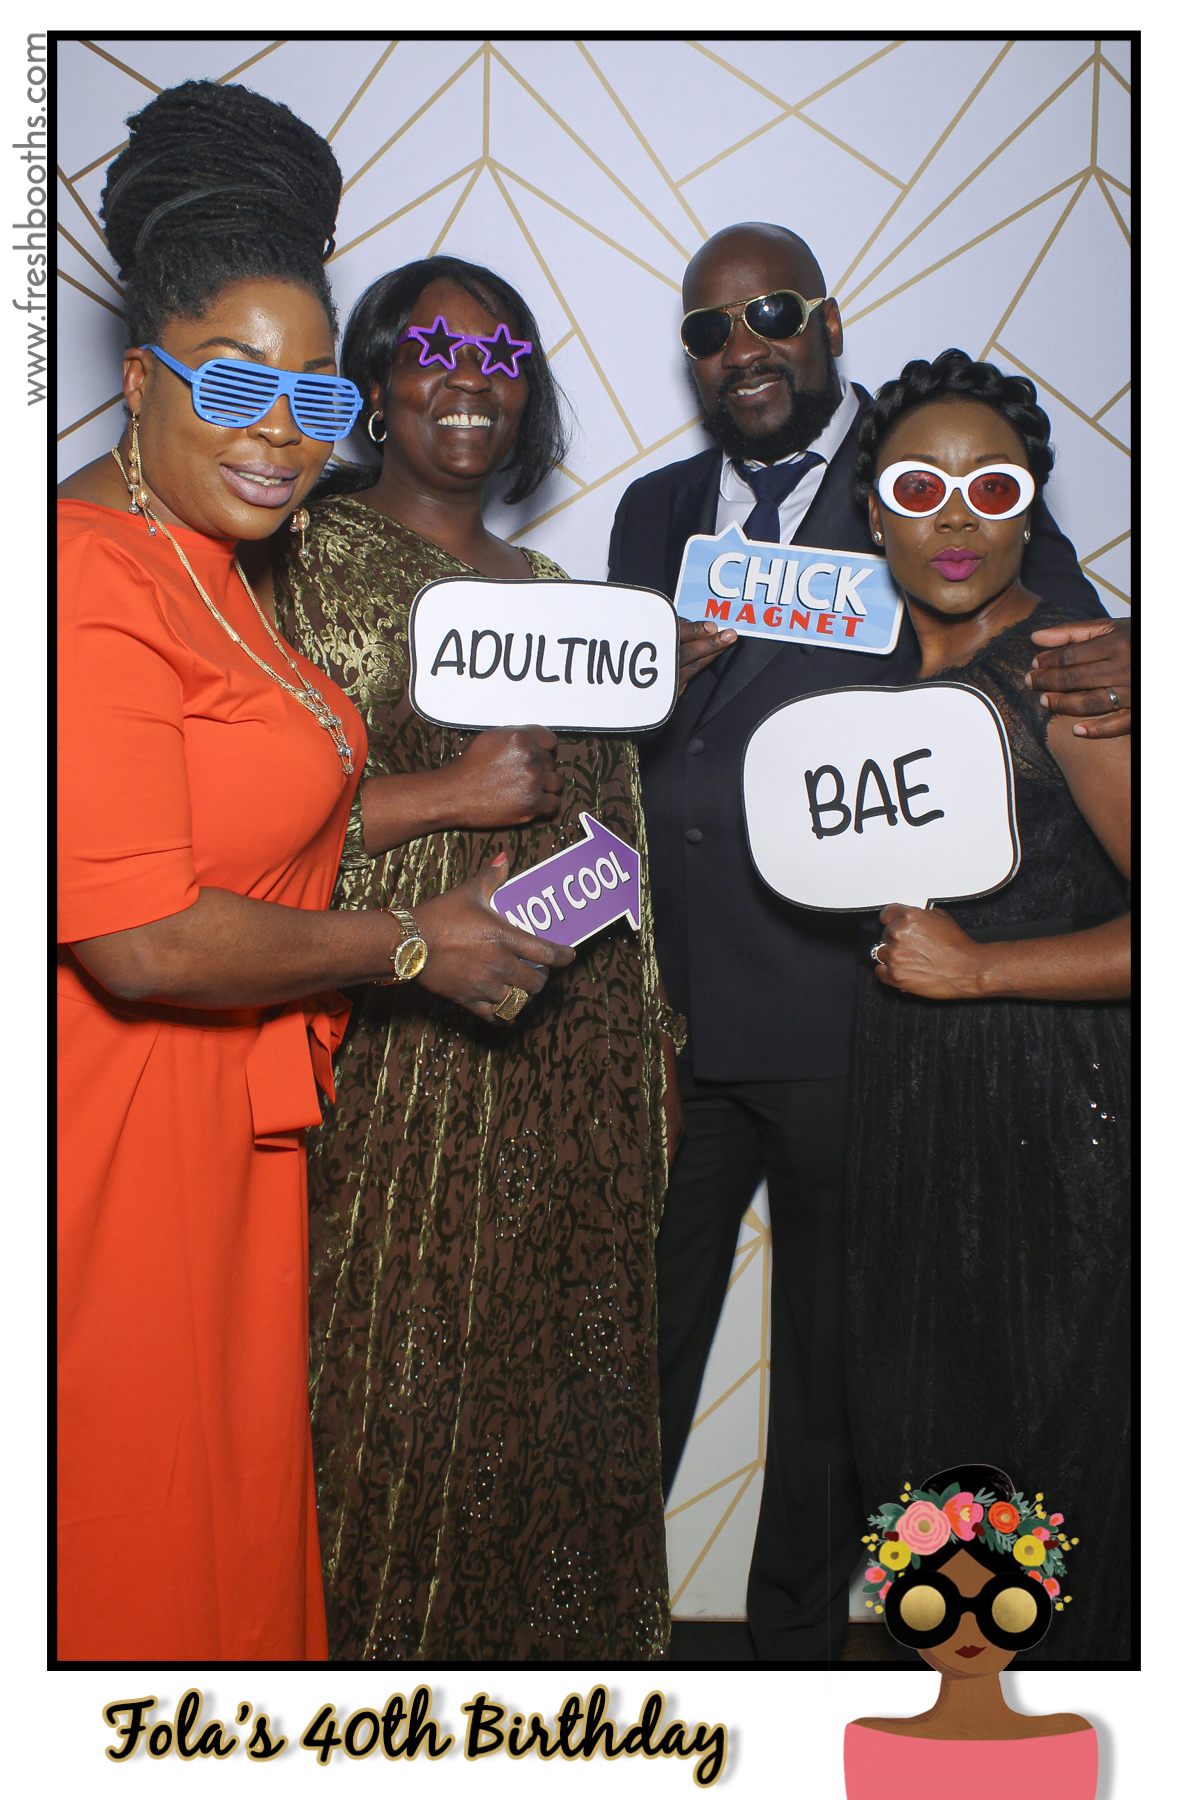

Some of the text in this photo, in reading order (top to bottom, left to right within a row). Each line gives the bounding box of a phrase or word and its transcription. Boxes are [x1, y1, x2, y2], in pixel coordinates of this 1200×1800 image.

[708, 552, 874, 616] CHICK
[704, 598, 864, 638] MAGNET
[430, 628, 659, 689] ADULTING
[804, 748, 945, 840] BAE
[505, 851, 631, 936] NOT COOL
